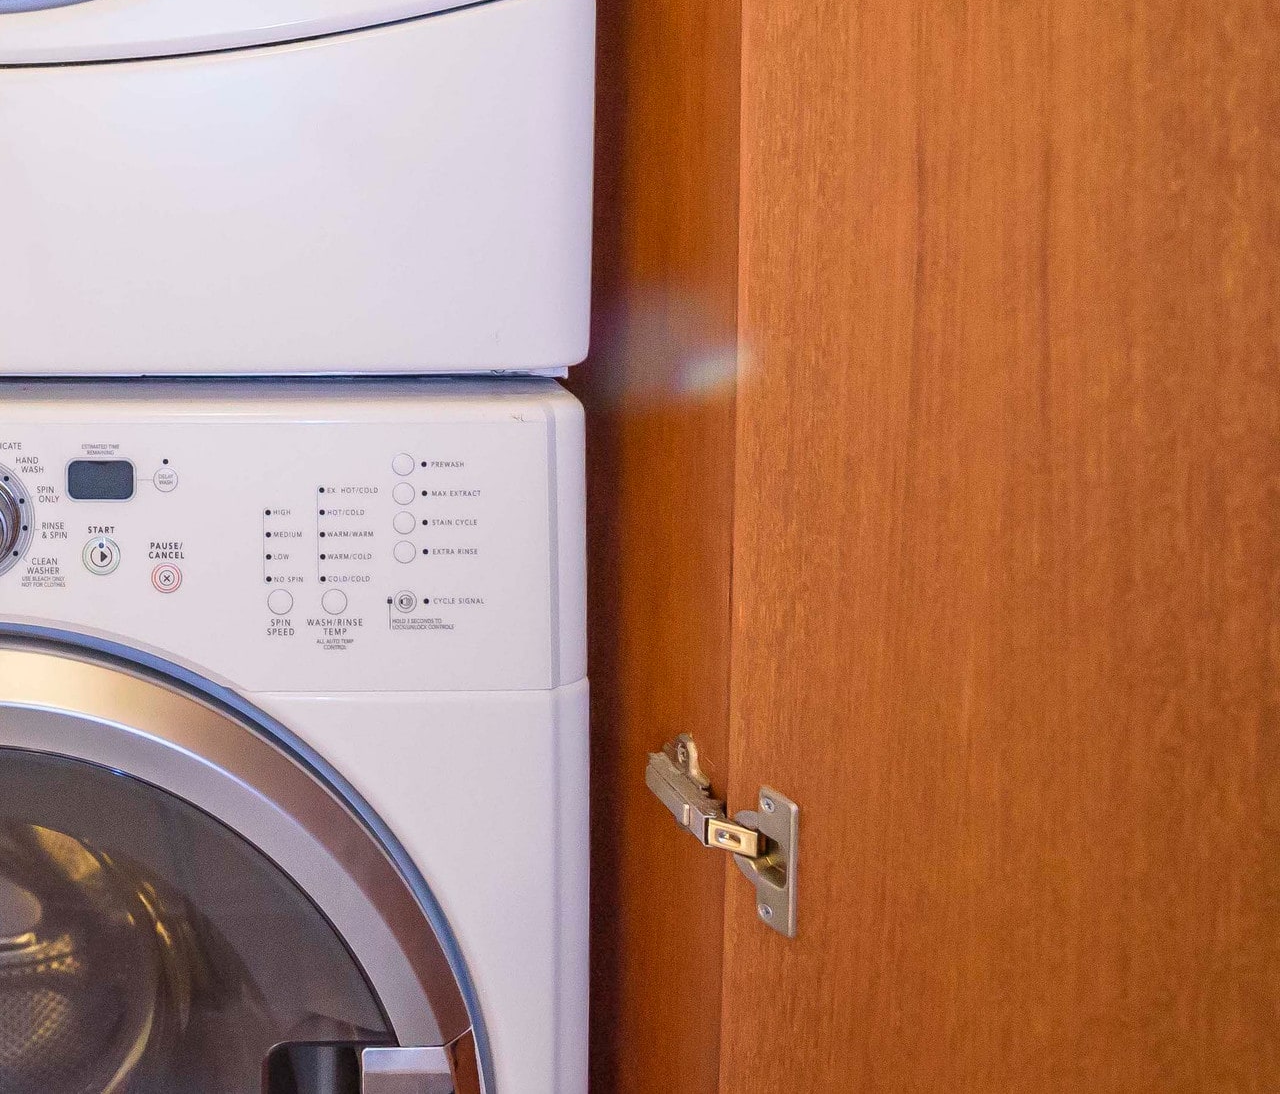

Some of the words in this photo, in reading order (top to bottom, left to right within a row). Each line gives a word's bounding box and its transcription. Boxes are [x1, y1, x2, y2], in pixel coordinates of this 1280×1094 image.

[21, 466, 45, 474] WASH
[36, 486, 55, 494] SPIN
[38, 495, 60, 503] ONLY
[41, 522, 64, 530] RINSE
[87, 526, 115, 534] START
[41, 531, 48, 539] &
[49, 531, 68, 539] SPIN
[150, 542, 183, 550] PAUSE/
[148, 551, 185, 559] CANCEL
[31, 558, 58, 566] CLEAN
[26, 567, 60, 575] WASHER
[270, 619, 291, 627] SPIN
[306, 619, 363, 627] WASH/RINSE
[267, 628, 295, 636] SPEED
[323, 628, 347, 636] TEMP
